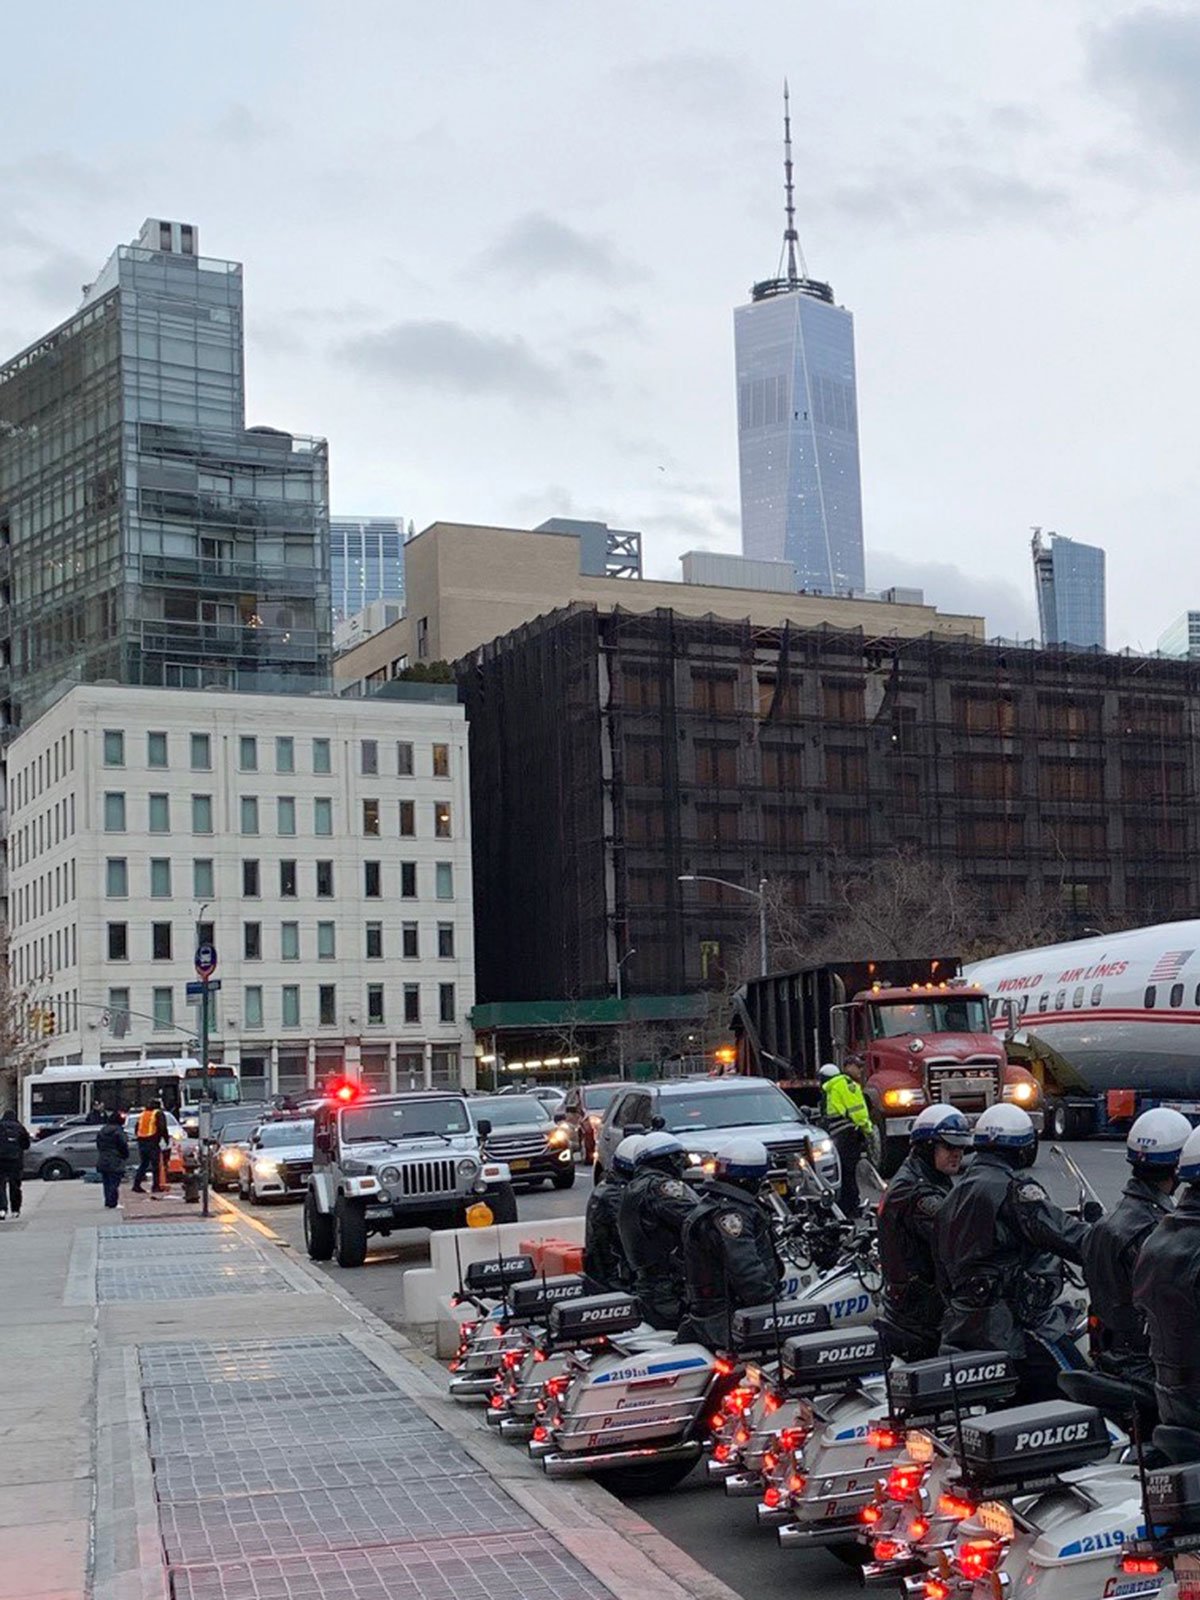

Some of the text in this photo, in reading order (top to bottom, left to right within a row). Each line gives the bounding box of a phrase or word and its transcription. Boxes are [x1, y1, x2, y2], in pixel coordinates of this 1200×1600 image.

[996, 974, 1043, 992] WORLD
[1136, 1137, 1157, 1146] NYPD
[483, 1260, 525, 1273] POLICE
[537, 1286, 583, 1300] POLICE
[580, 1305, 631, 1322] POLICE
[763, 1312, 816, 1330] POLICE
[817, 1343, 876, 1364] POLICE
[610, 1368, 637, 1381] 2191
[942, 1363, 1006, 1387] POLICE
[1014, 1422, 1090, 1451] POLICE
[1146, 1484, 1173, 1494] POLICE
[1082, 1530, 1125, 1552] 2119
[1103, 1577, 1164, 1598] COURTESY
